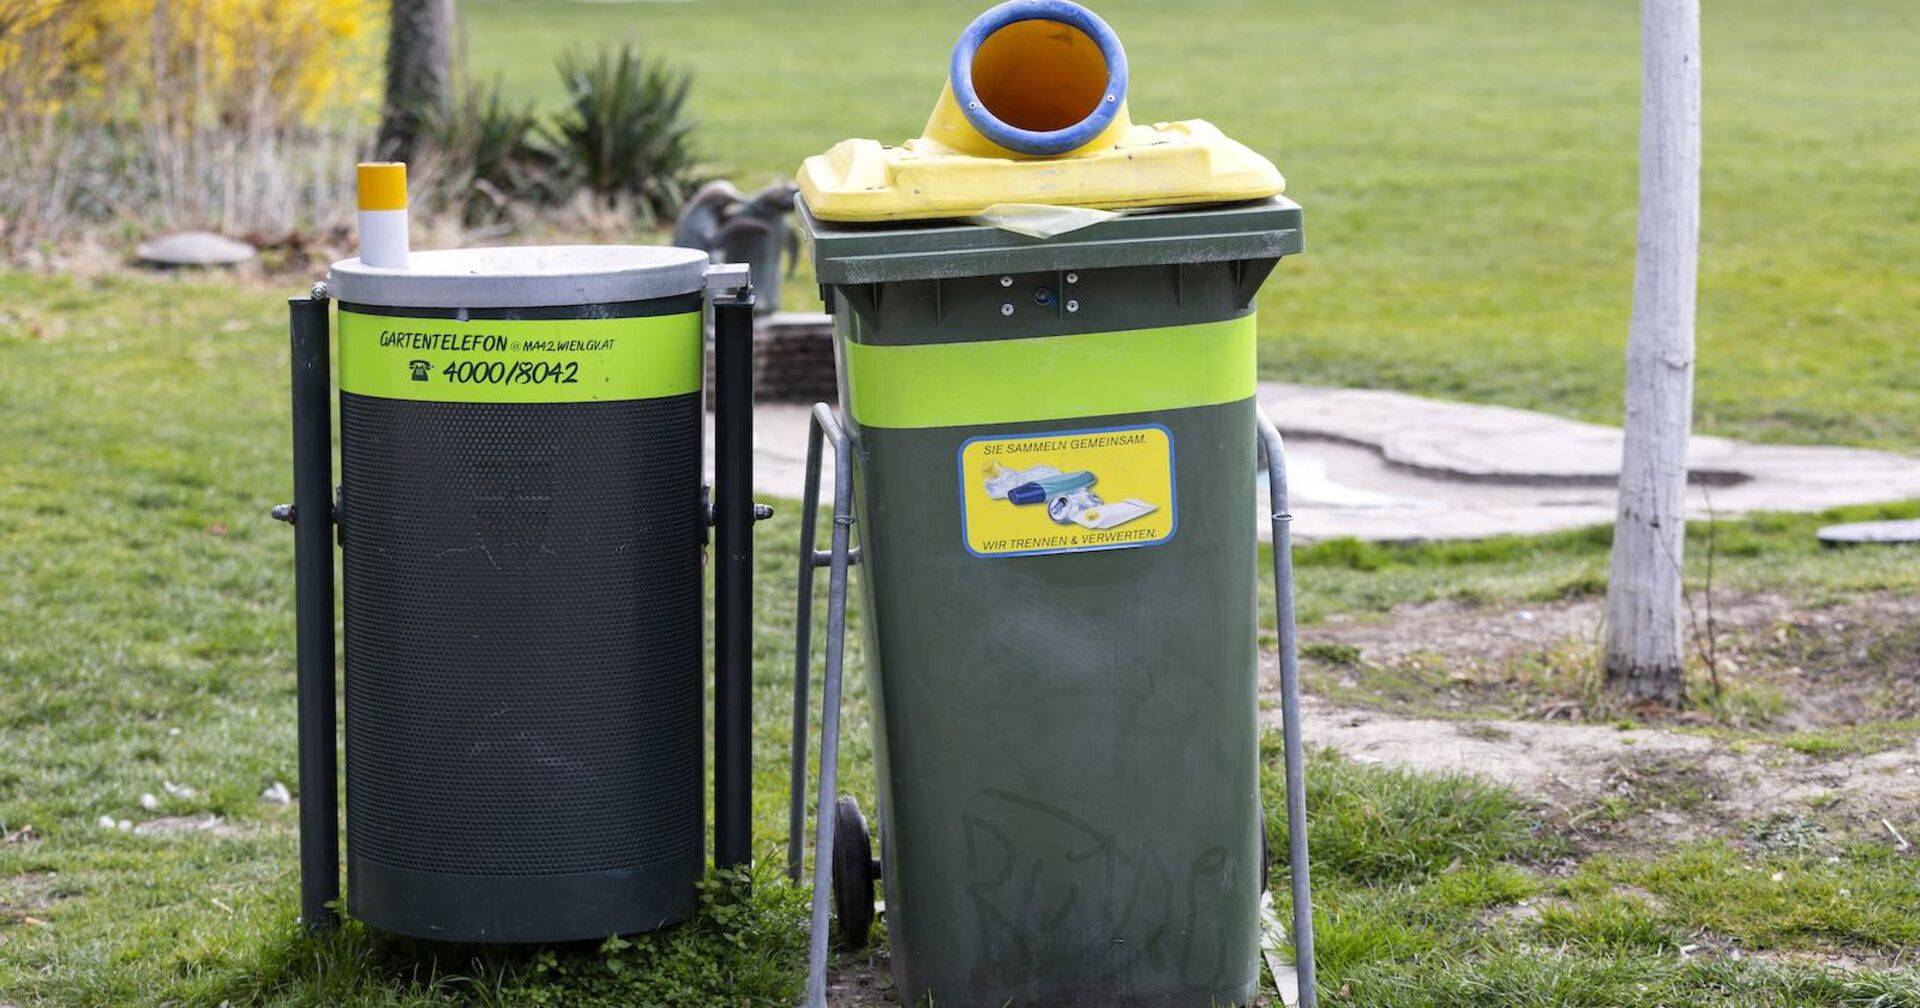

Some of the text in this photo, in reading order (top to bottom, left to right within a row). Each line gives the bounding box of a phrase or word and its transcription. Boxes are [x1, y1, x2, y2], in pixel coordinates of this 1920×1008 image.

[379, 330, 507, 352] GARTENTELEFON
[442, 360, 579, 386] 4000/8042
[983, 434, 1147, 456] SIE SAMMELN GEMEINSAM.
[983, 529, 1158, 551] WIR TRENNEN & VERWERTEN.
